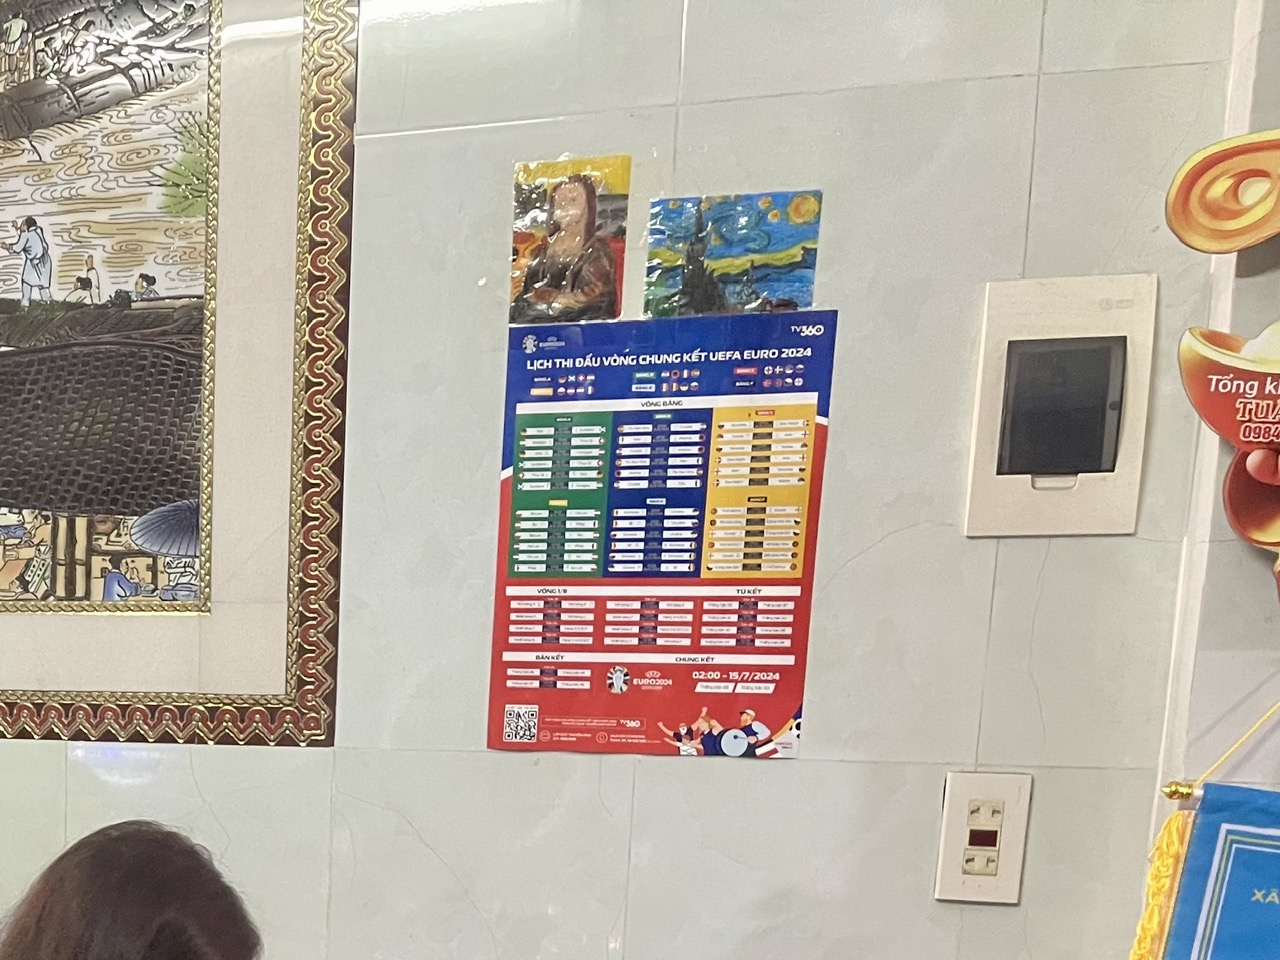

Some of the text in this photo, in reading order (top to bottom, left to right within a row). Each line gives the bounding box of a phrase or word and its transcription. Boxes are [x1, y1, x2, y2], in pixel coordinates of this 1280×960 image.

[791, 324, 825, 337] TV360
[526, 347, 812, 371] LỊCH THI ĐẤU VÒNG CHUNG KẾT UEFA EURO 2024
[1207, 373, 1280, 398] Tổng k
[692, 671, 721, 680] 02:00
[729, 671, 780, 681] 15/7/2024
